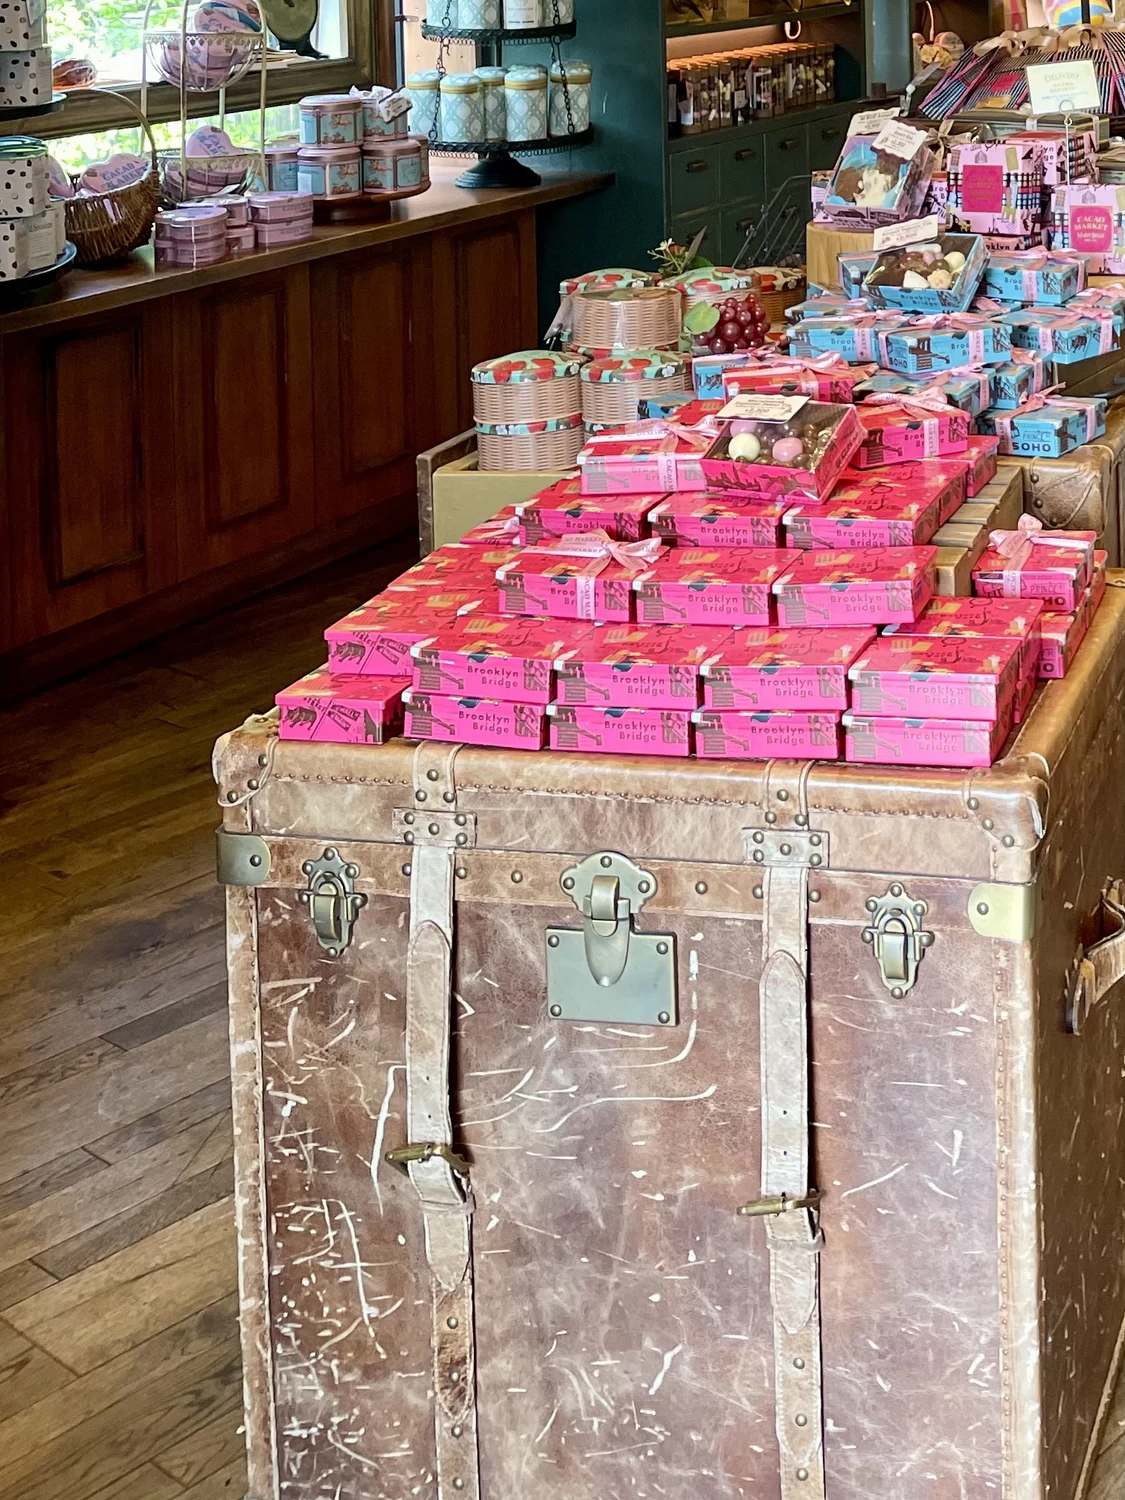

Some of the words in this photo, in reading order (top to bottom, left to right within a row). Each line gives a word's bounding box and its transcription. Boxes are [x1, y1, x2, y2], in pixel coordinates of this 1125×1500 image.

[1044, 71, 1080, 83] DELIVERY
[102, 163, 136, 181] CACAO
[105, 165, 148, 191] MARKE
[1077, 215, 1106, 223] CACAO
[986, 242, 1011, 251] oklyn
[900, 294, 937, 302] Brooklyn
[889, 357, 908, 369] SOHO
[1012, 442, 1051, 452] SOHO
[665, 459, 673, 481] CACAO
[565, 521, 611, 531] Brooklyn
[701, 526, 748, 536] Brooklyn
[836, 528, 885, 540] Brooklyn
[714, 536, 748, 546] Bridge
[850, 538, 885, 548] Bridge
[1031, 585, 1057, 593] PRINCE
[687, 594, 738, 604] Brooklyn
[830, 594, 883, 604] Brooklyn
[702, 603, 739, 613] Bridge
[846, 602, 883, 612] Bridge
[467, 665, 520, 678] Brooklyn
[481, 676, 519, 688] Bridge
[612, 674, 665, 686] Brooklyn
[760, 677, 814, 688] Brooklyn
[627, 684, 665, 695] Bridge
[775, 687, 814, 697] Bridge
[909, 684, 965, 696] Brooklyn
[925, 694, 965, 705] Bridge
[458, 710, 510, 724] Brooklyn
[472, 721, 510, 735] Bridge
[604, 720, 657, 732] Brooklyn
[751, 725, 805, 736] Brooklyn
[619, 731, 657, 742] Bridge
[766, 734, 805, 745] Bridge
[903, 730, 959, 742] Brooklyn
[918, 741, 959, 752] Bridge
